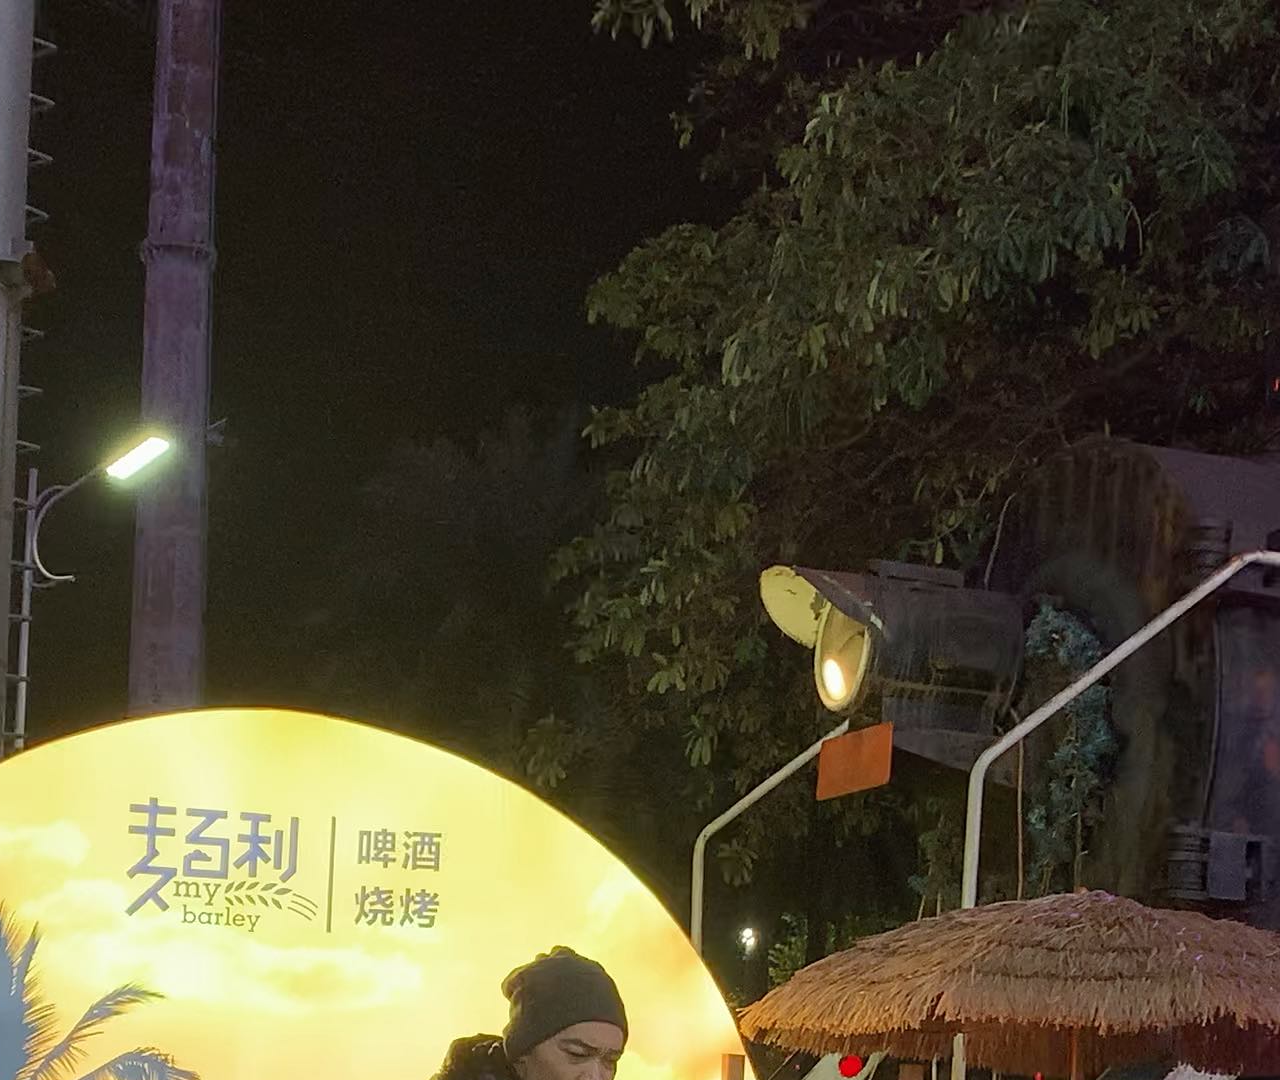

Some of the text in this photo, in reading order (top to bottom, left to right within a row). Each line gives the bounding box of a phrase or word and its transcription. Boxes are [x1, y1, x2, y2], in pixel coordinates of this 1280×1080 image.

[356, 828, 443, 873] 啤酒
[172, 879, 222, 907] my
[354, 884, 440, 929] 烧烤
[180, 903, 261, 933] barley
